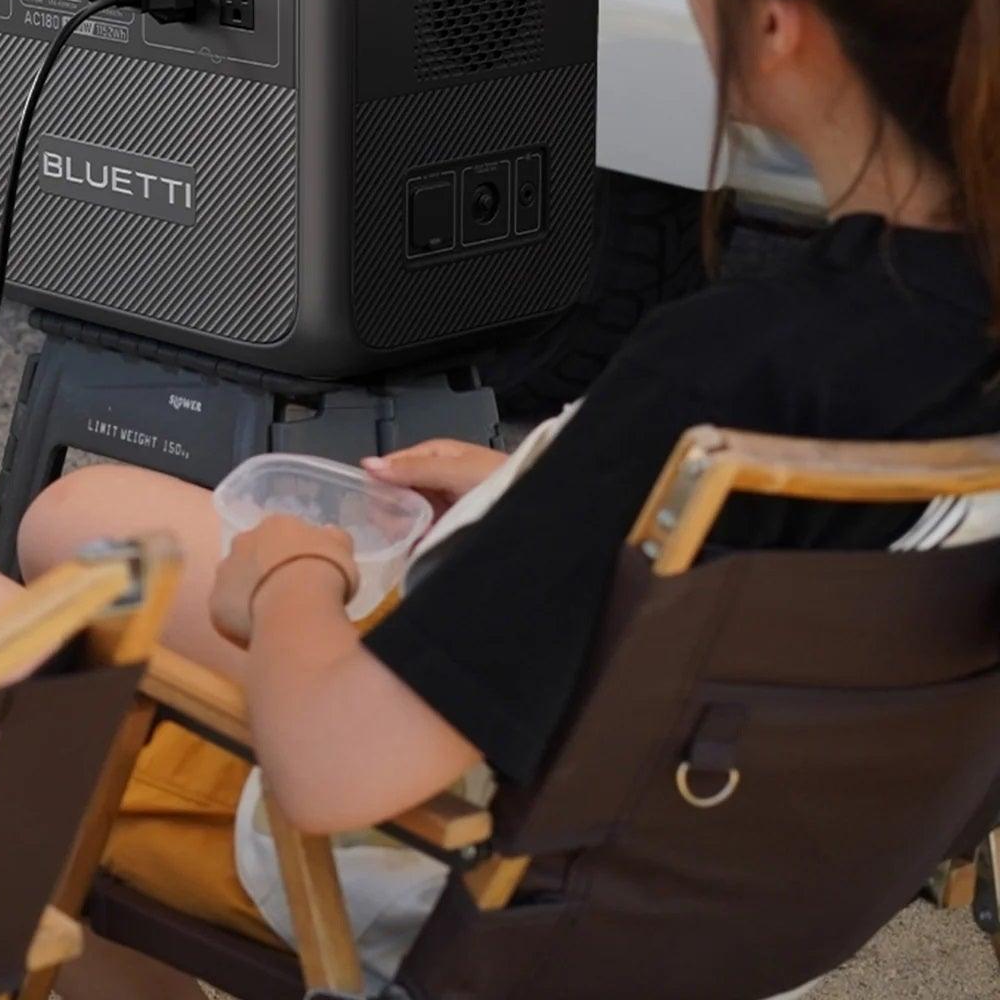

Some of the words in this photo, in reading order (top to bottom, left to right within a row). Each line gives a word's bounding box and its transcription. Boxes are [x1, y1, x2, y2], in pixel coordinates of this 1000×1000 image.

[24, 10, 60, 30] AC180
[43, 151, 192, 209] BLUETTI
[87, 418, 119, 438] LIMIT
[120, 428, 158, 449] WEIGHT
